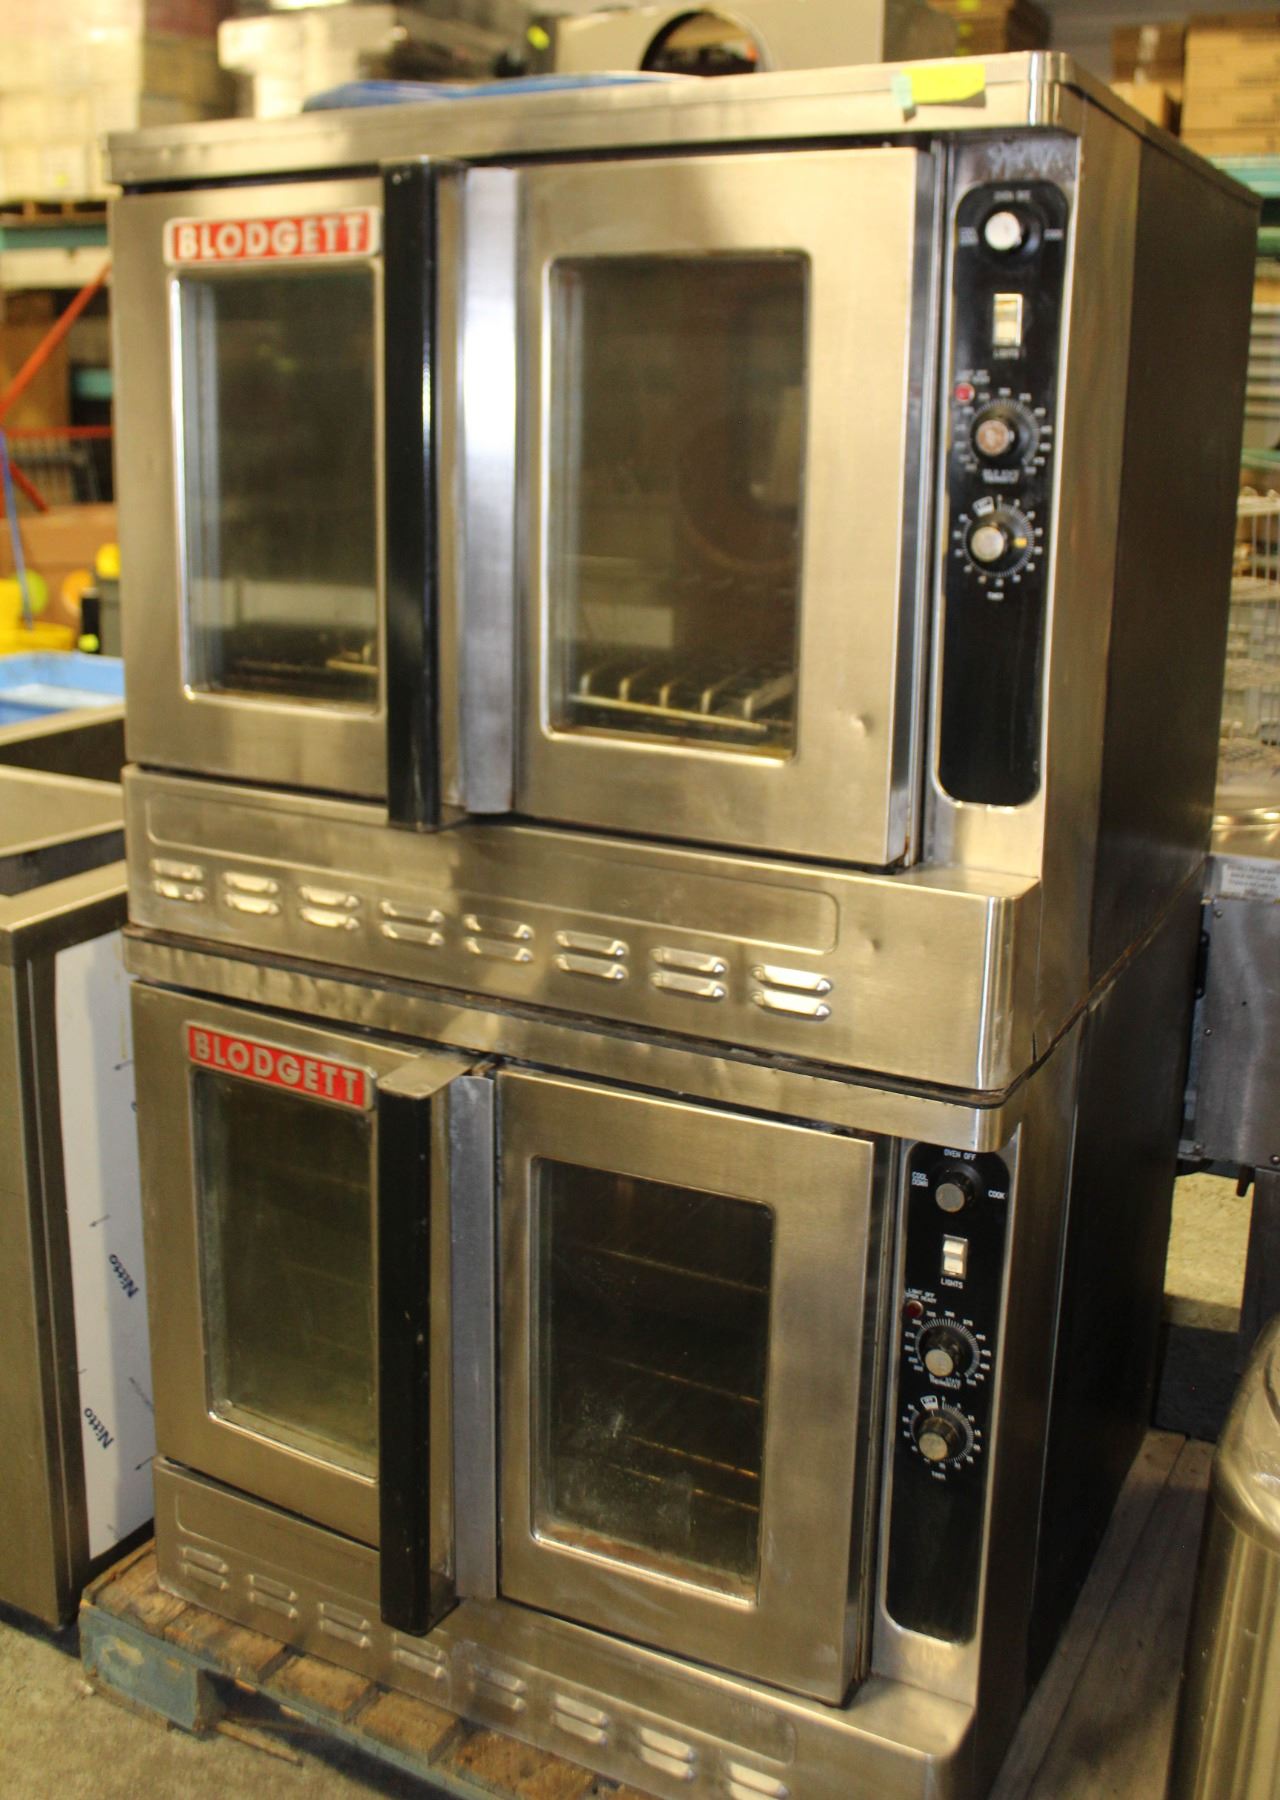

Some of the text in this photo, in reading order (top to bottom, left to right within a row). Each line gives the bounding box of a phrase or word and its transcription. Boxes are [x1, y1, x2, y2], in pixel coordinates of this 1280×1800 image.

[177, 213, 365, 259] BLODGETT
[194, 1031, 360, 1102] BLODGETT
[963, 1152, 976, 1160] OFF
[988, 1190, 1005, 1199] COOK
[108, 1253, 139, 1299] Nitto
[941, 1278, 963, 1288] LIGHTS
[84, 1406, 115, 1449] Nitto
